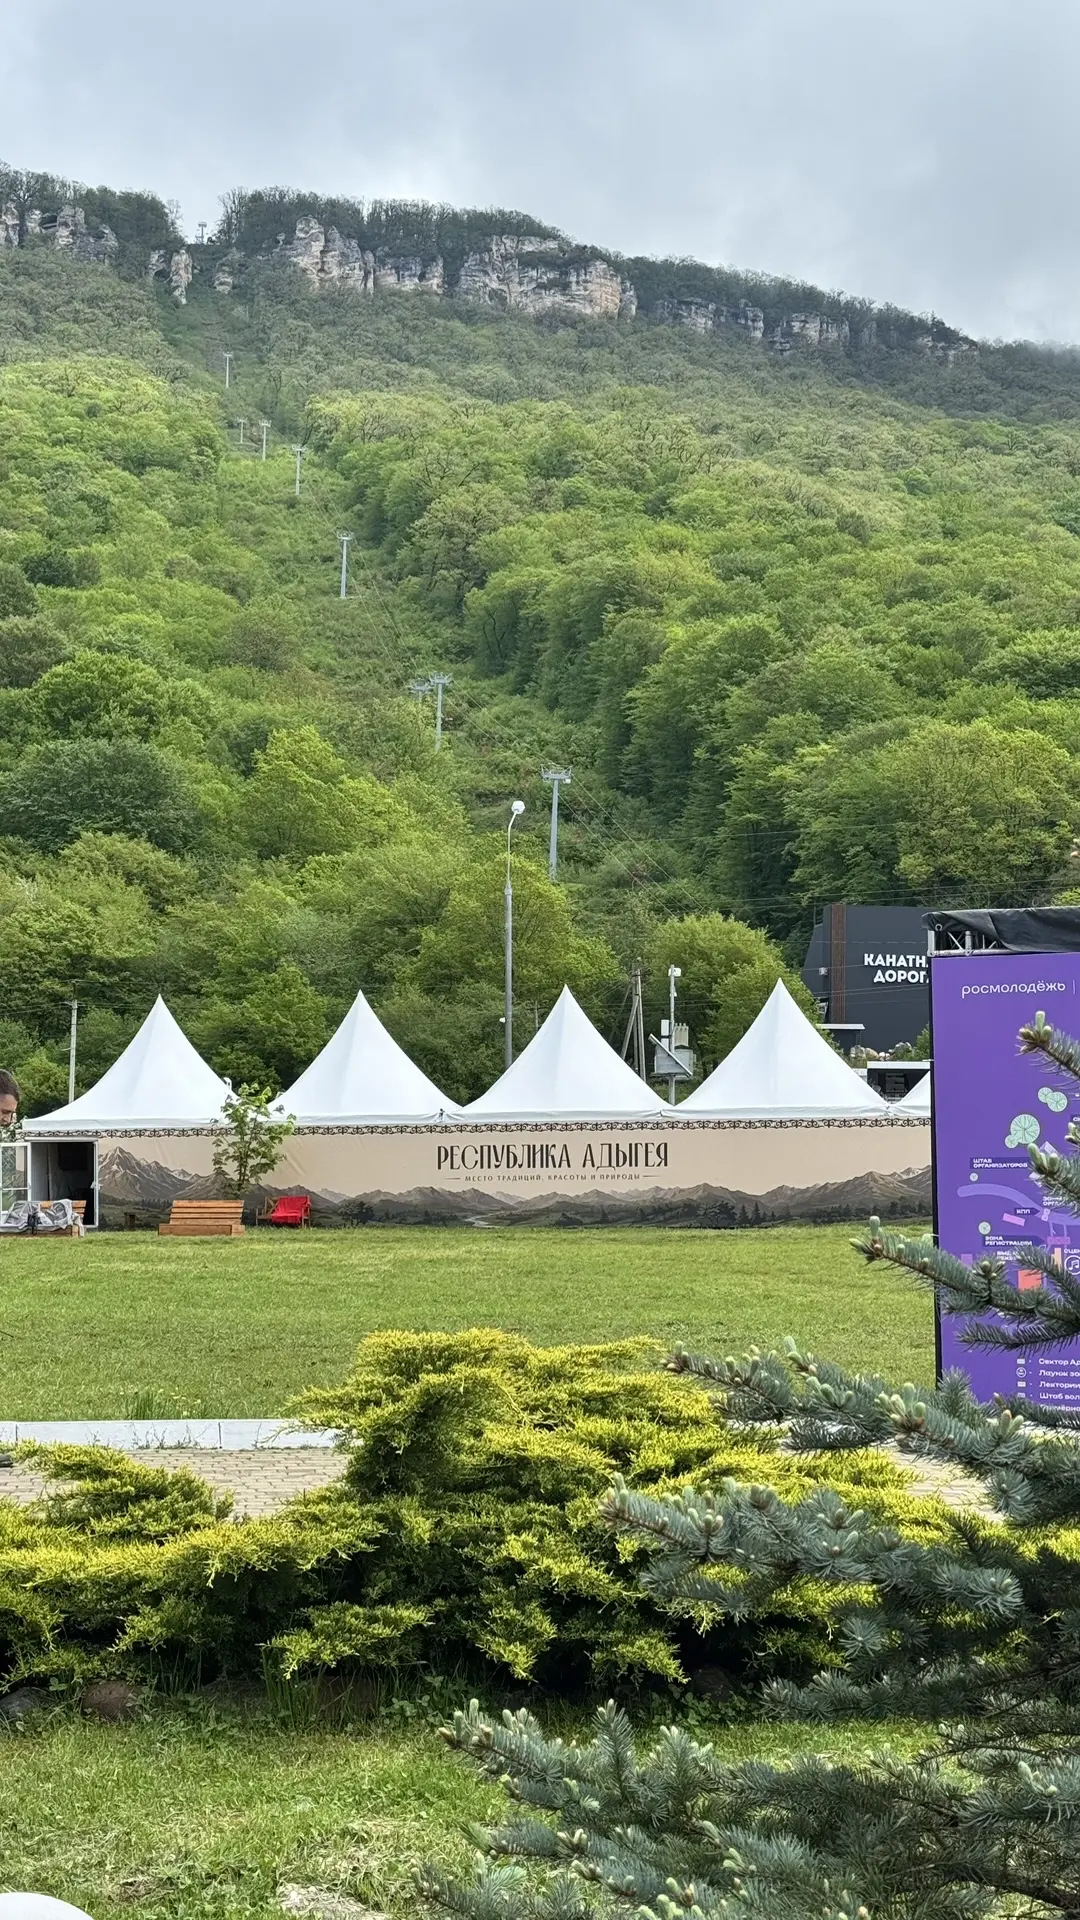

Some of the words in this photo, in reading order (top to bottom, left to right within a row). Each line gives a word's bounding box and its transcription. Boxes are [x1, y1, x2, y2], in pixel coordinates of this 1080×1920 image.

[864, 953, 928, 968] КАНАТН
[873, 969, 929, 983] ДОРОГ
[961, 980, 1066, 999] росмолодёжь
[437, 1144, 571, 1170] РЕСПУБЛИКА
[582, 1142, 668, 1171] АДЫГЕЯ
[600, 1173, 640, 1181] ПРИРОДЫ
[1038, 1358, 1069, 1366] Сектор
[1039, 1369, 1069, 1377] Лаунж
[1040, 1392, 1064, 1400] Штаб
